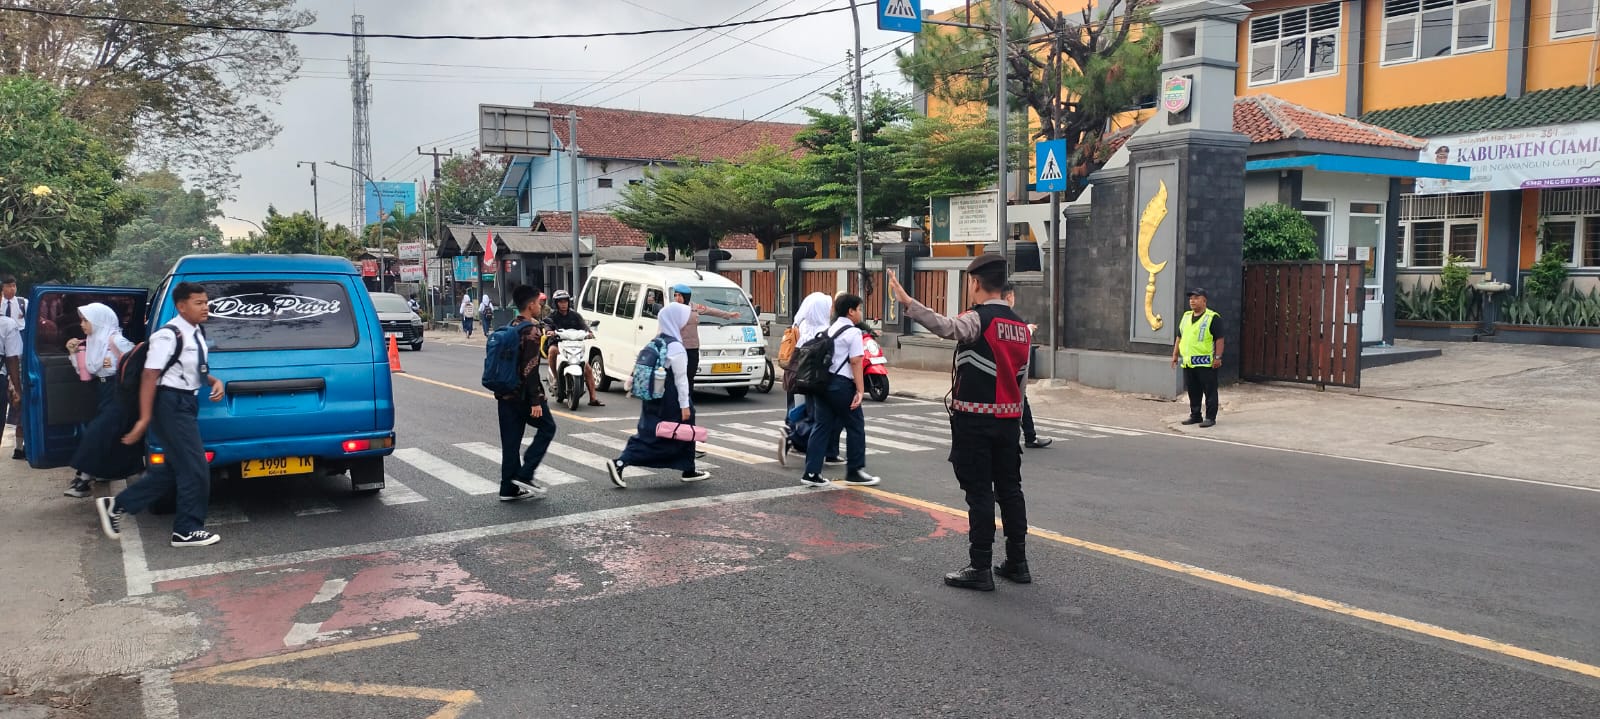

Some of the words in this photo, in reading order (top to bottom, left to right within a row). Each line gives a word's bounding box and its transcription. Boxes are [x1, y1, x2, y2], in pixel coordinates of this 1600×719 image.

[1457, 141, 1546, 162] KABUPATEN
[1489, 160, 1550, 171] NGAWANGUN
[214, 298, 271, 315] Dua
[272, 296, 341, 315] Putri
[997, 322, 1028, 343] POLISI
[244, 459, 250, 472] Z
[259, 457, 287, 471] 1990
